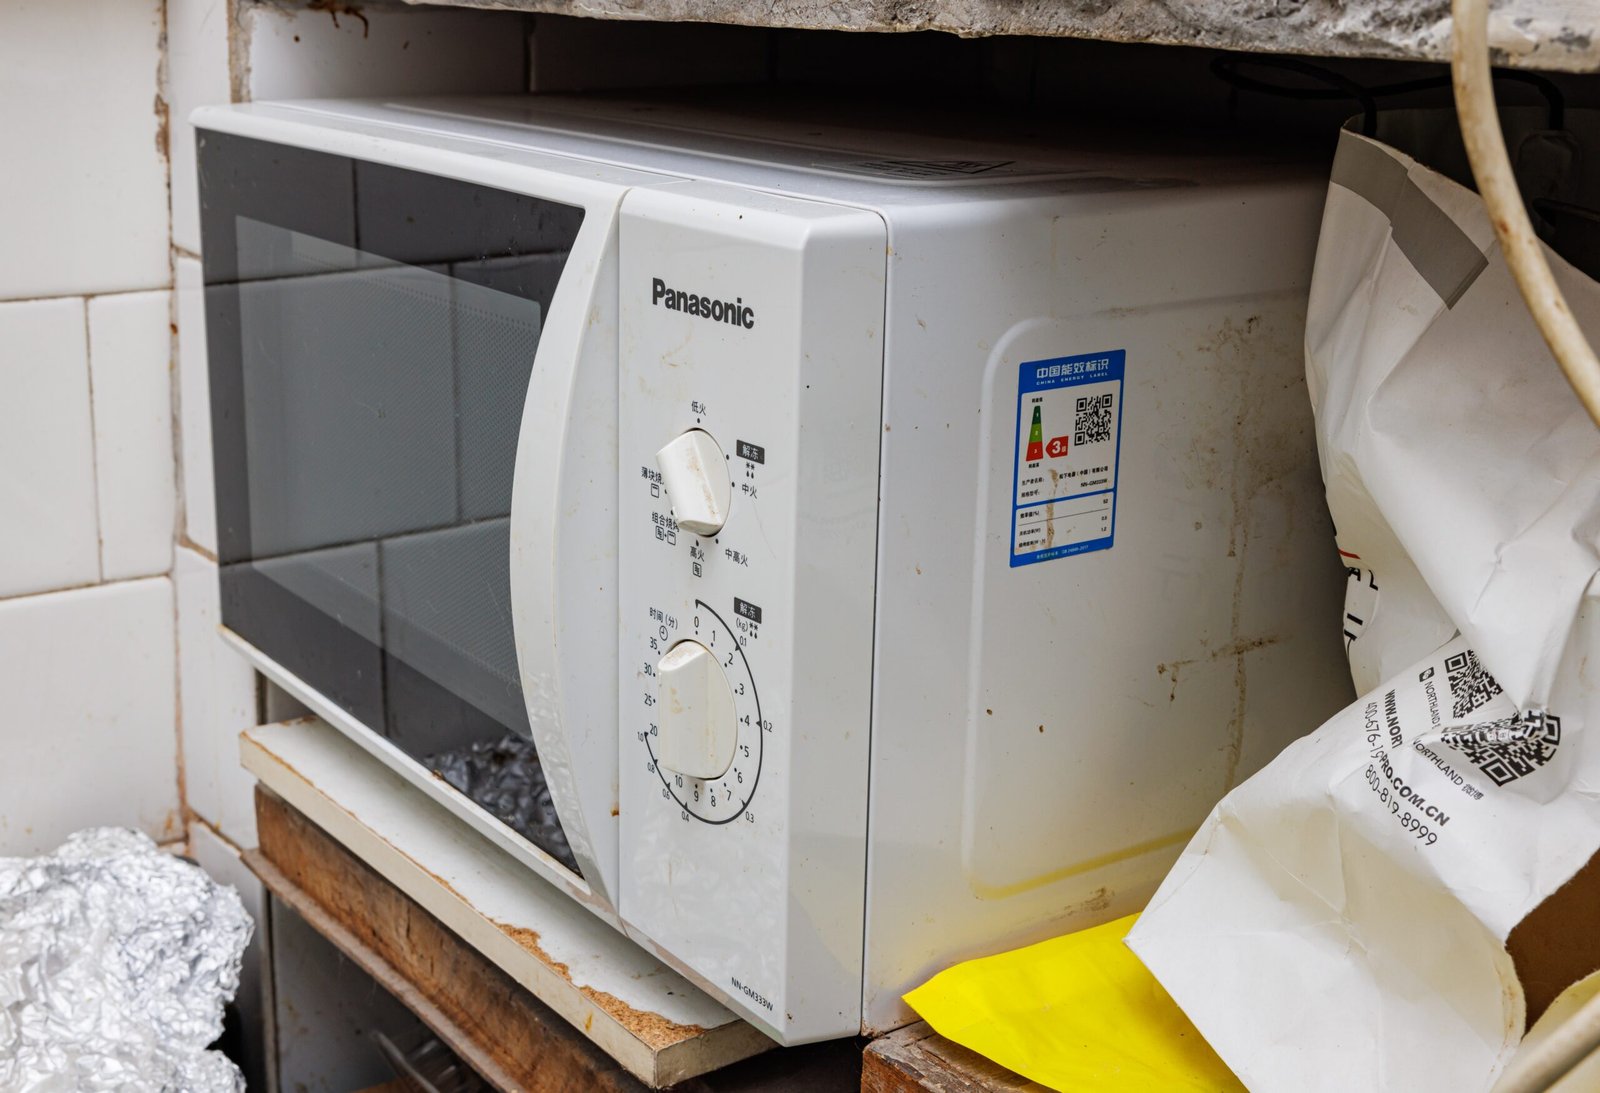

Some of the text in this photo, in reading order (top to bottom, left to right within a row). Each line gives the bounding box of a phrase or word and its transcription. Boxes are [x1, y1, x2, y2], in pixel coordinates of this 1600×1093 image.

[652, 277, 754, 329] Panasonic
[1036, 358, 1109, 379] 中国能效标识
[691, 400, 707, 416] 低火
[742, 444, 759, 460] 解冻
[641, 466, 664, 485] 薄块烧
[741, 483, 758, 499] 中火
[690, 545, 705, 562] 高火
[725, 547, 749, 567] 中高火
[739, 602, 756, 619] 解冻
[649, 607, 678, 630] 时间 (分)
[693, 616, 699, 628] 0
[735, 617, 749, 632] (kg)
[649, 636, 658, 650] 35
[711, 630, 716, 642] 1
[739, 637, 747, 647] 0.1
[727, 652, 734, 665] 2
[643, 662, 652, 676] 30
[738, 683, 744, 695] 3
[644, 693, 652, 707] 25
[1424, 681, 1441, 725] NORTHLAND
[744, 714, 750, 726] 4
[763, 720, 772, 733] 0.2
[649, 723, 658, 737] 20
[744, 745, 750, 758] 5
[647, 762, 655, 774] 0.8
[674, 774, 683, 788] 10
[737, 771, 743, 784] 6
[662, 788, 670, 800] 0.6
[693, 790, 699, 802] 9
[726, 789, 732, 801] 7
[1461, 783, 1484, 801] 微博
[710, 795, 716, 807] 8
[1365, 764, 1438, 846] 800-819-8999
[681, 810, 689, 822] 0.4
[745, 811, 754, 823] 0.3
[731, 976, 774, 1011] NN-GM333W
